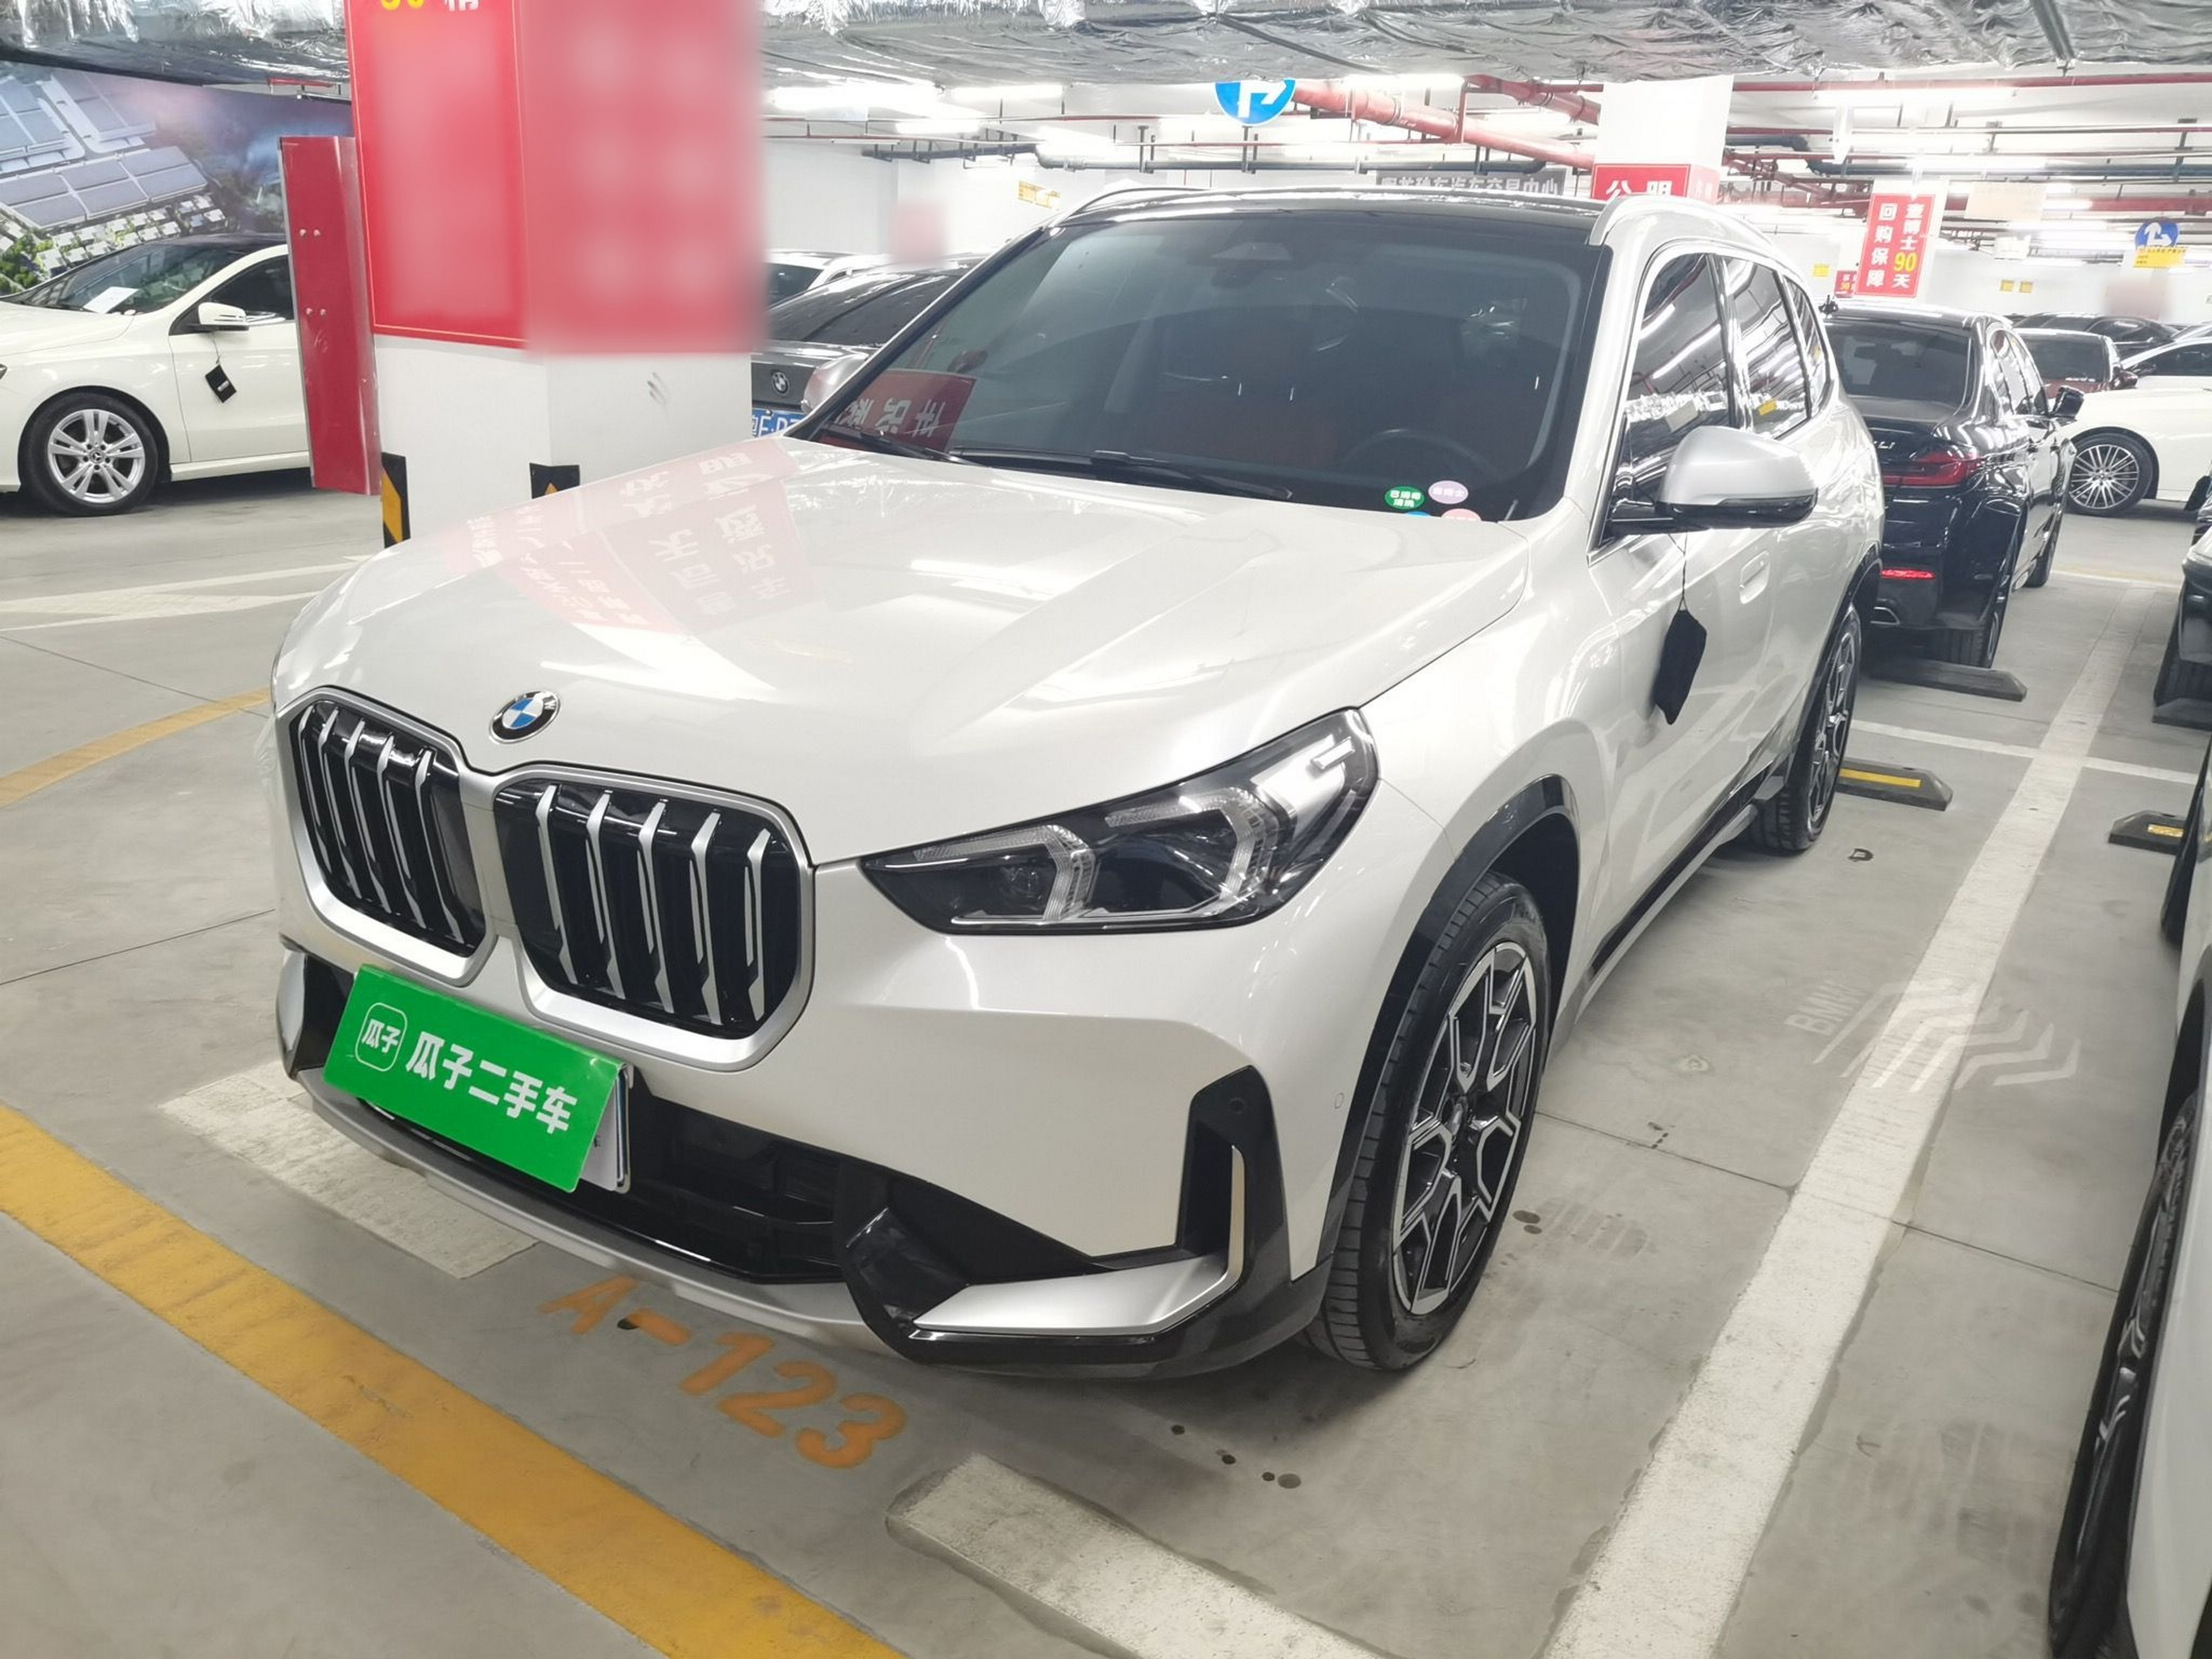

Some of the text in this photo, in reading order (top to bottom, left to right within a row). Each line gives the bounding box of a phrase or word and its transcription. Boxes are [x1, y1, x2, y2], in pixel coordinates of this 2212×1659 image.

[1866, 203, 1897, 287] 回购保障
[361, 1017, 578, 1135] 瓜子 瓜子二手车
[537, 1275, 908, 1469] A-123
